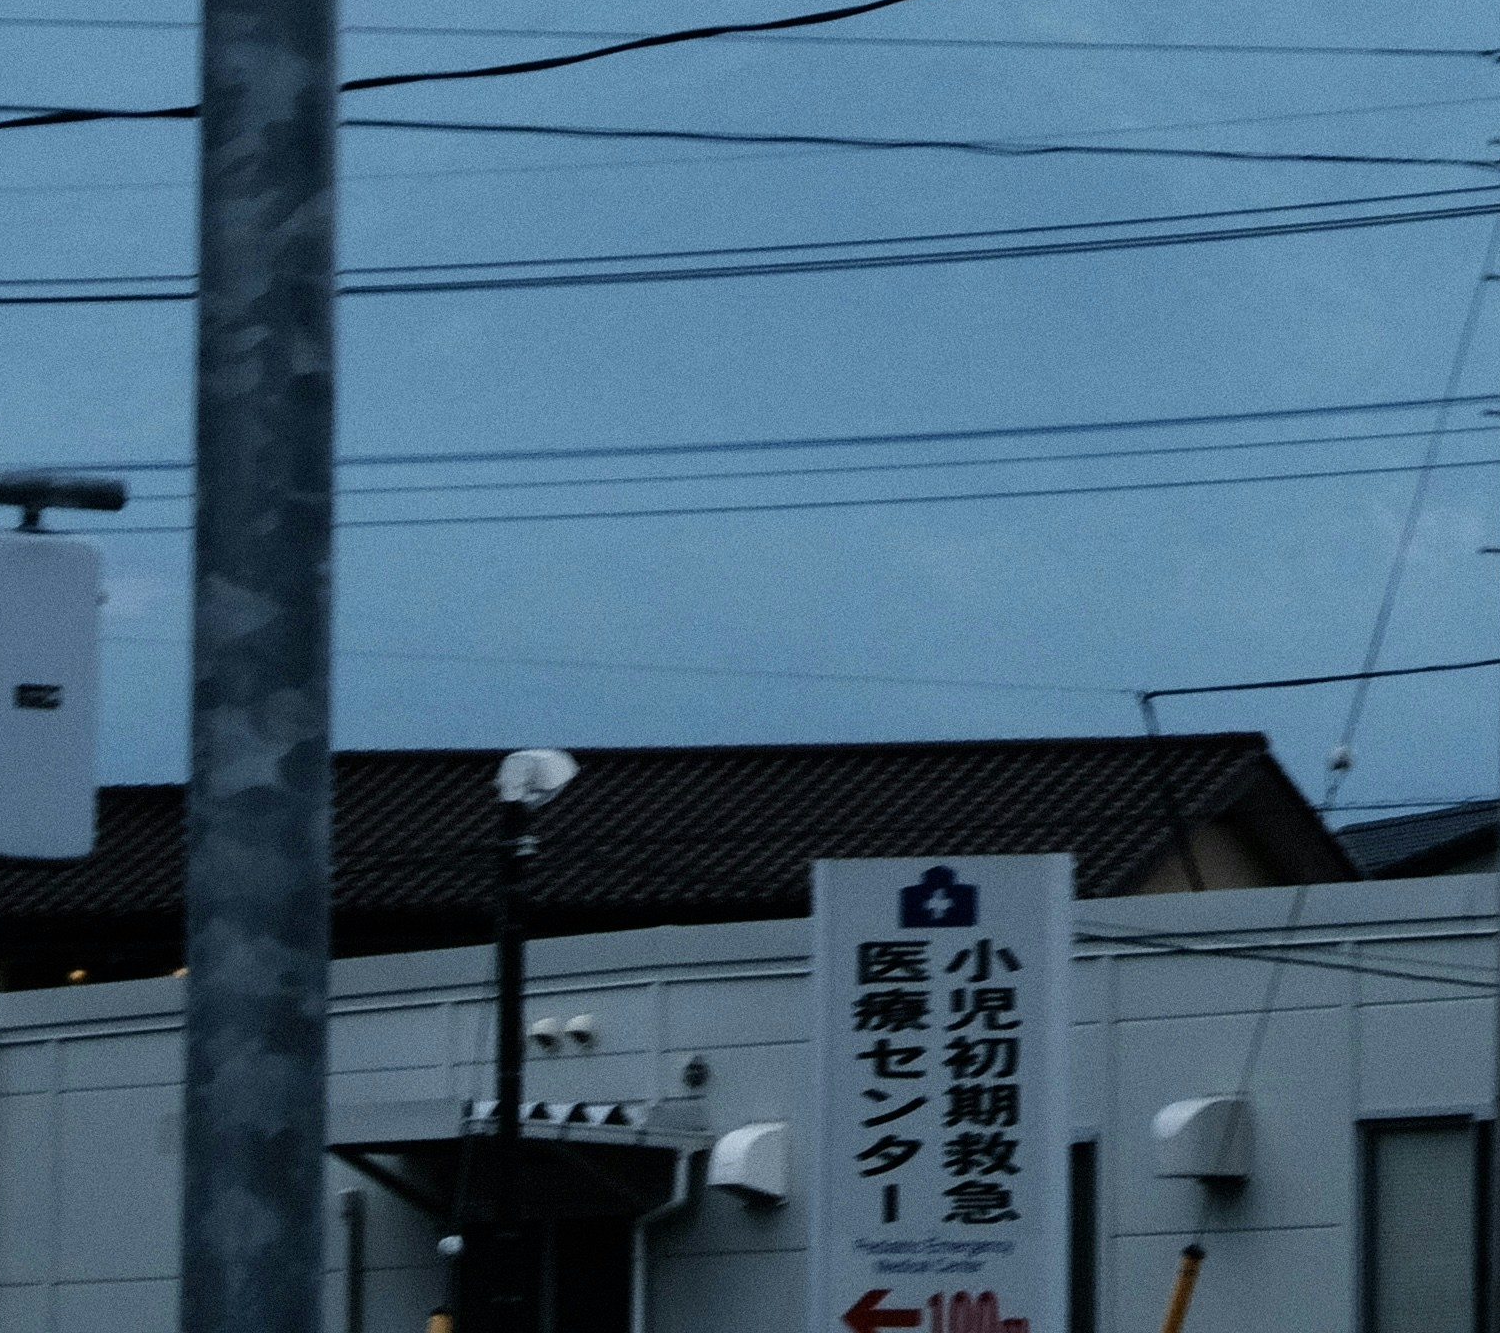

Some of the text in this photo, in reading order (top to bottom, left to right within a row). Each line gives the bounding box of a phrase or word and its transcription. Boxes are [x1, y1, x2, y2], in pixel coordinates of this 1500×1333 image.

[852, 940, 931, 1224] 医療センター
[942, 938, 1022, 1225] 小児初期救急
